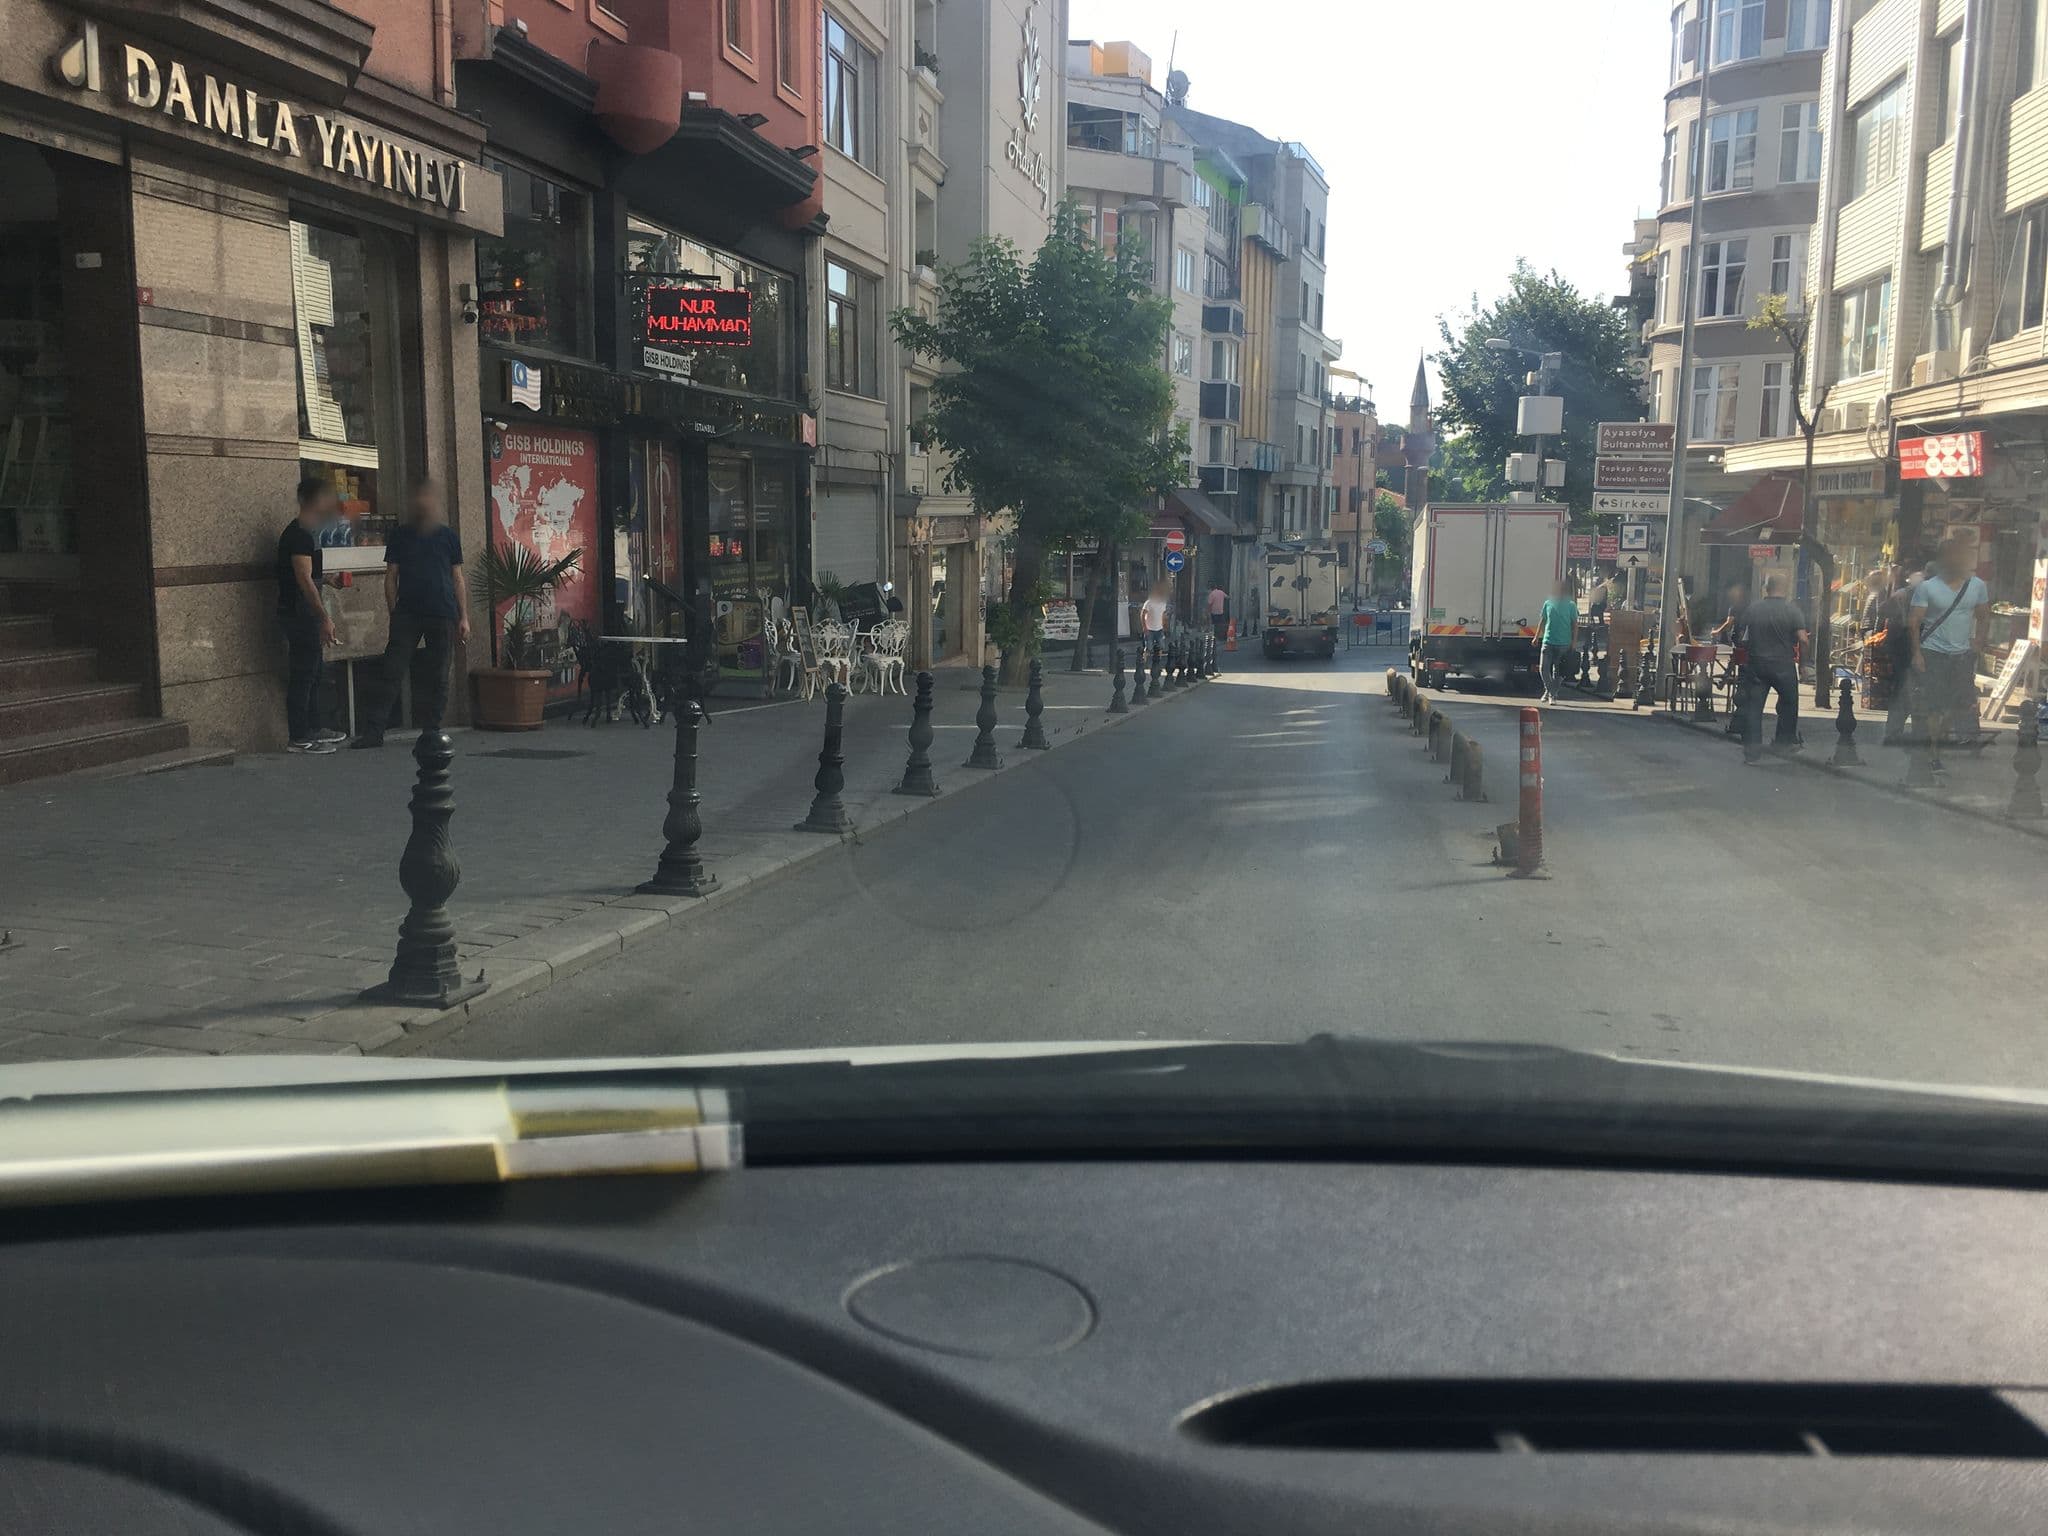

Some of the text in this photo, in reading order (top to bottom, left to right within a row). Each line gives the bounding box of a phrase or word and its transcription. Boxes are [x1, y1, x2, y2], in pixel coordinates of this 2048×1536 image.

[124, 44, 467, 212] DAMLA YAYINEVİ
[680, 298, 717, 315] NUR
[649, 315, 748, 332] MUHAMMAD
[644, 350, 690, 372] GISB HOLDINGS
[1603, 428, 1656, 438] Ayasofya
[505, 434, 585, 456] GISB HOLDINGS
[1602, 440, 1669, 449] Sultanahmet
[520, 452, 572, 467] INTERNATIONAL
[1610, 498, 1660, 509] Sirkeci
